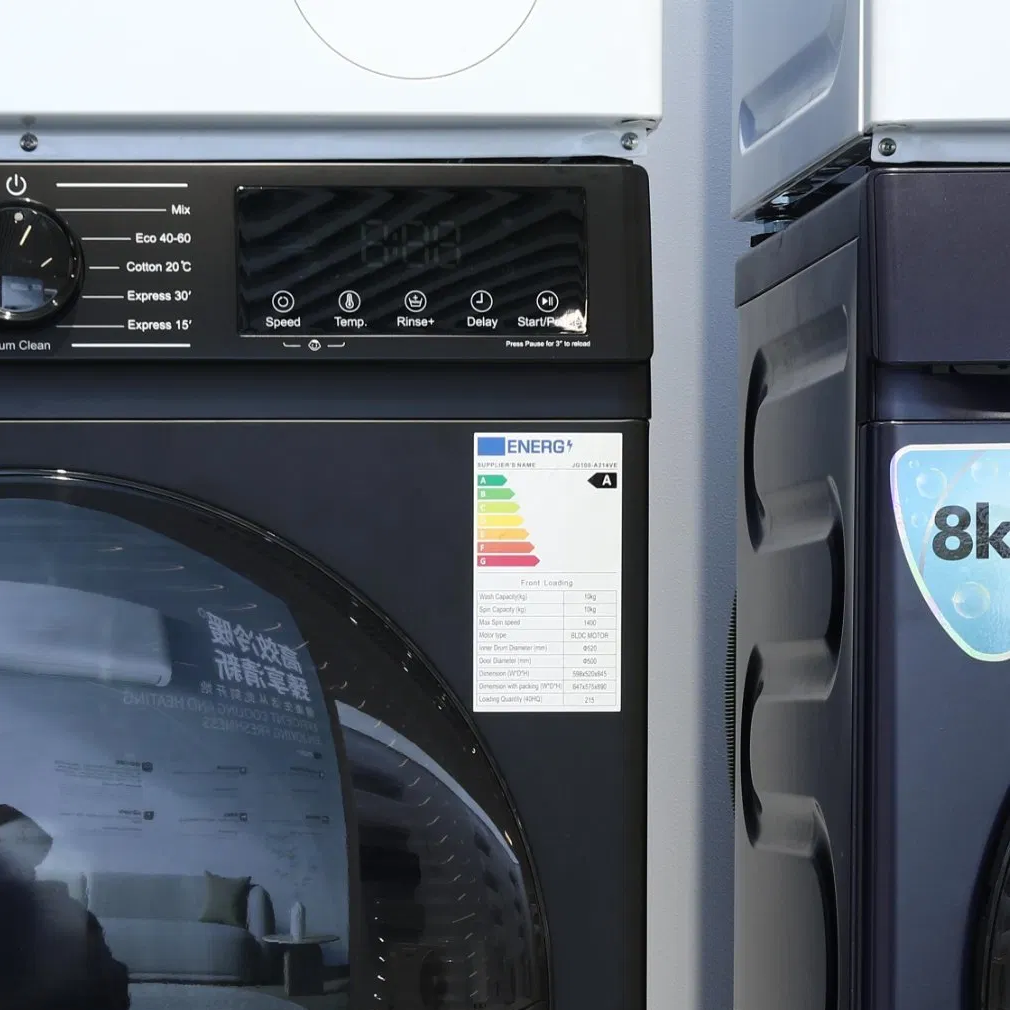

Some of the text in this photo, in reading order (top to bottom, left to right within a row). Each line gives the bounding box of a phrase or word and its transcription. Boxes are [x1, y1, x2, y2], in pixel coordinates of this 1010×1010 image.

[171, 204, 190, 215] Mix
[135, 233, 191, 244] Eco 40-60
[126, 261, 163, 273] Cotton
[127, 290, 172, 303] Express
[127, 319, 172, 332] Express
[265, 316, 301, 329] Speed
[333, 316, 367, 329] Temp.
[397, 316, 435, 327] Rinse+
[467, 316, 498, 330] Delay
[18, 339, 51, 351] Clean
[507, 439, 565, 454] ENERG
[480, 477, 486, 485] A
[601, 474, 612, 486] A
[480, 490, 486, 498] B
[480, 557, 486, 565] G
